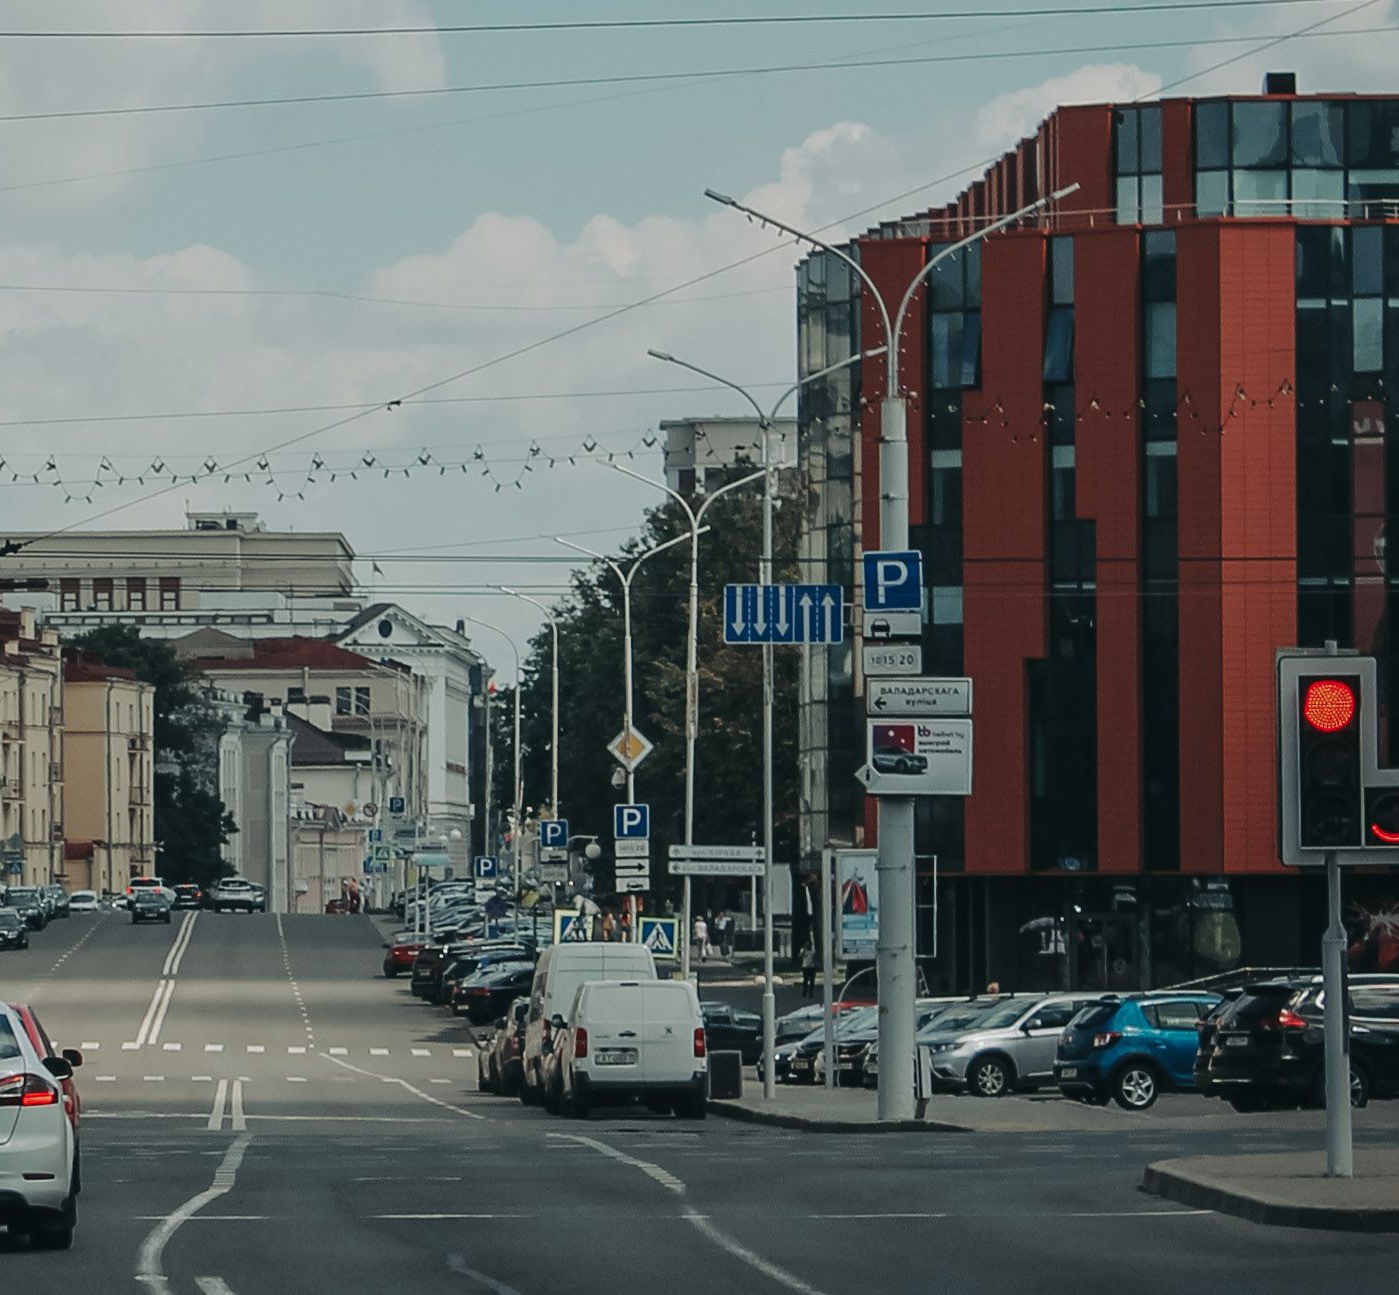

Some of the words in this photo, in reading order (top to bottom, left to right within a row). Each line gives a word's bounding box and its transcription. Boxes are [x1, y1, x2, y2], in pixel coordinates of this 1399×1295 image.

[876, 560, 908, 603] P
[883, 655, 895, 665] 15
[899, 655, 914, 665] 20
[880, 687, 960, 696] ВАЛАДАРСКАГА
[623, 808, 642, 835] P
[546, 824, 562, 844] P
[480, 858, 492, 876] P
